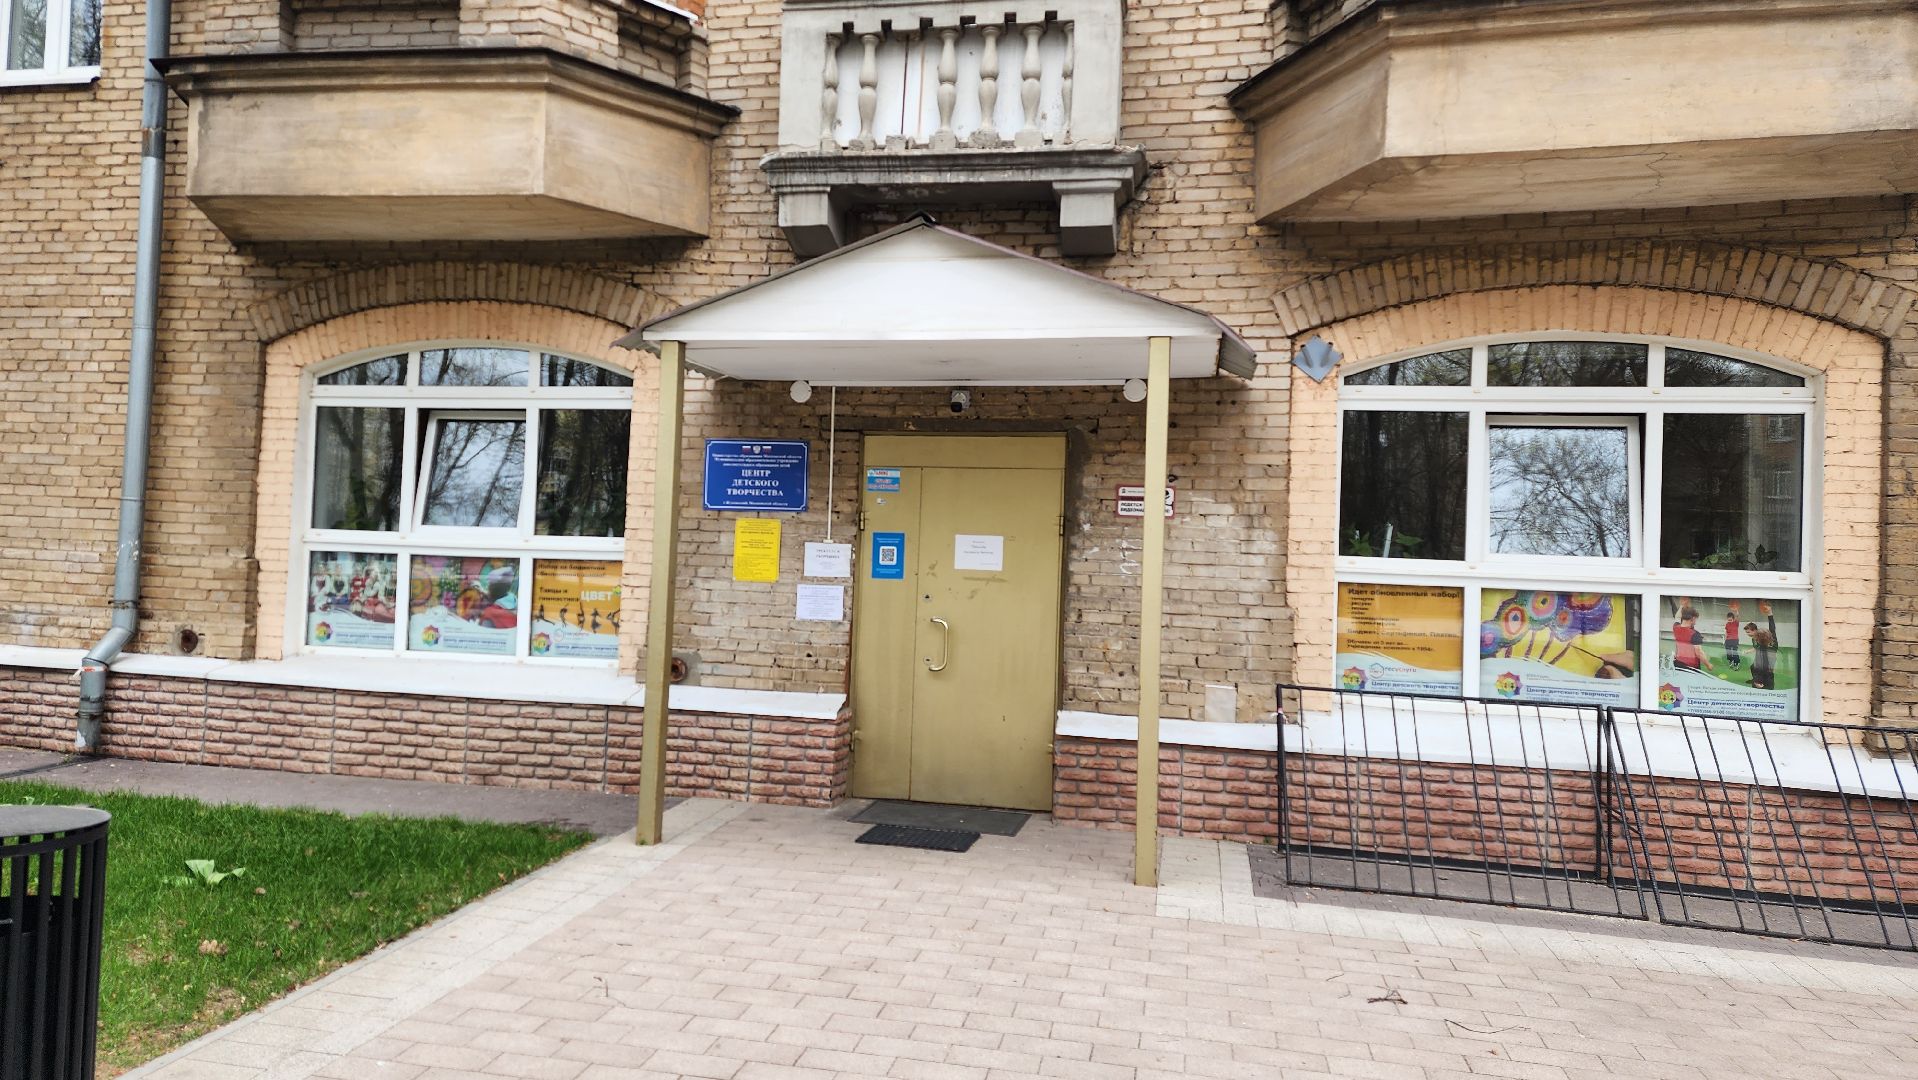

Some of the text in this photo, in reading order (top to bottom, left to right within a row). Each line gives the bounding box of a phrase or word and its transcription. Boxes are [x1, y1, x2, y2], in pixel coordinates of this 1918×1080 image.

[741, 469, 771, 477] ЦЕНТР
[732, 479, 779, 487] ДЕТСКОГО
[726, 488, 784, 496] ТВОРЧЕСТВА
[580, 590, 613, 602] ЦВЕТ
[1580, 691, 1620, 699] творчества
[1743, 702, 1785, 710] творчества
